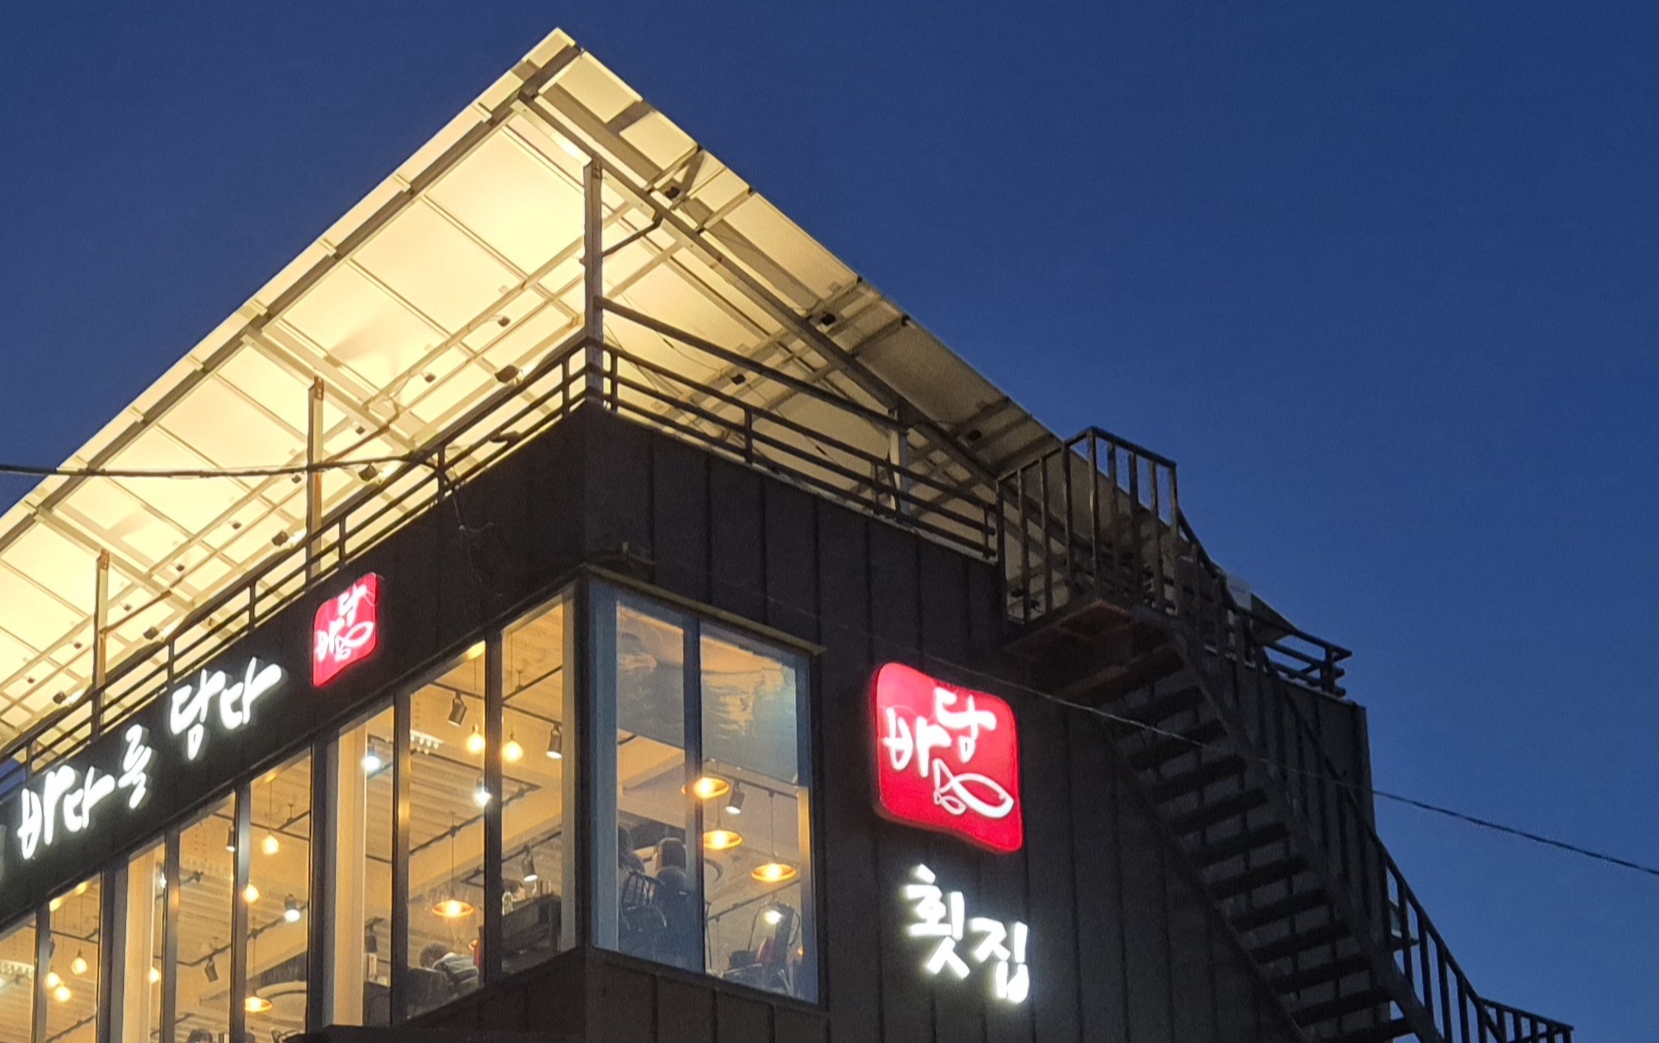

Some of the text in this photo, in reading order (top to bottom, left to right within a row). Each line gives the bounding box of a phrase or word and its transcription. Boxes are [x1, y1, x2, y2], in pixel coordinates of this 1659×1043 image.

[18, 725, 153, 860] 바다를
[169, 657, 284, 761] 담다
[903, 863, 1029, 1005] 횟집
